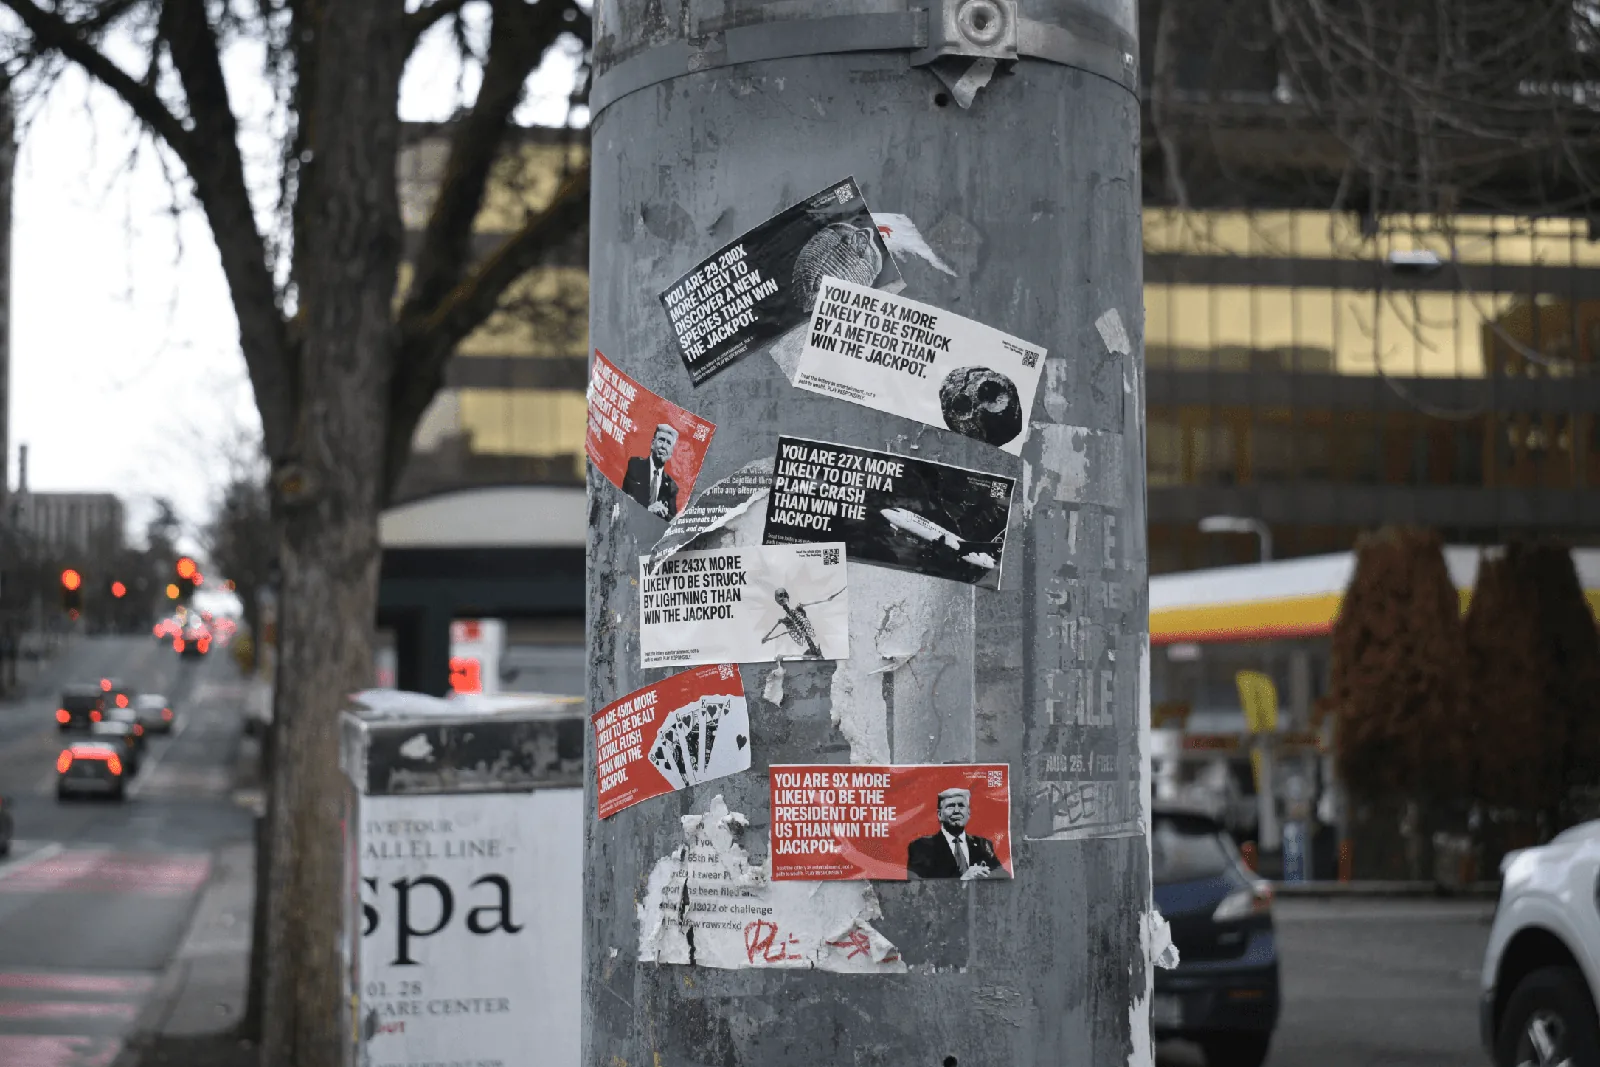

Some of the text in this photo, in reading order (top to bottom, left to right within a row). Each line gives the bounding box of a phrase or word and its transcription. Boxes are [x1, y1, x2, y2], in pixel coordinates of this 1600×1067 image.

[665, 244, 748, 307] YOU ARE 29,200X
[670, 260, 748, 322] MORE LIKELY TO
[674, 269, 762, 336] DISCOVER A NEW
[680, 278, 778, 349] SPECIES THAN WIN
[824, 286, 938, 330] YOU ARE 4X MORE
[684, 340, 706, 362] THE
[707, 309, 758, 349] JACKPOT.
[818, 301, 952, 352] LIKELY TO BE STRUCK
[814, 318, 936, 364] BY A METEOR THAN
[811, 333, 927, 379] WIN THE JACKPOT.
[618, 378, 637, 402] MORE
[618, 396, 630, 415] THE
[612, 406, 620, 424] OF
[620, 412, 632, 432] THE
[612, 424, 626, 445] THE
[782, 444, 904, 478] YOU ARE 27X MORE
[778, 460, 820, 480] LIKELY
[823, 467, 839, 482] TO
[842, 471, 863, 487] DIE
[866, 476, 881, 490] IN
[883, 478, 892, 492] A
[775, 477, 816, 496] PLANE
[819, 483, 865, 503] CRASH
[774, 492, 866, 520] THAN WIN THE
[770, 509, 831, 532] JACKPOT.
[662, 559, 679, 574] ARE
[682, 558, 706, 574] 243X
[709, 556, 741, 571] MORE
[644, 572, 747, 592] LIKELY TO BE STRUCK
[644, 588, 741, 608] BY LIGHTNING THAN
[644, 605, 734, 624] WIN THE JACKPOT.
[605, 709, 617, 726] ARE
[618, 700, 634, 720] 450X
[634, 690, 658, 712] MORE
[612, 722, 621, 738] TO
[622, 717, 631, 732] BE
[632, 707, 655, 727] DEALT
[602, 739, 619, 759] ROYAL
[620, 728, 642, 751] FLUSH
[599, 745, 643, 779] THAN WIN THE
[1046, 754, 1067, 772] AUG
[600, 768, 628, 794] JACKPOT.
[775, 773, 890, 788] YOU ARE 9X MORE
[775, 790, 884, 804] LIKELY TO BE THE
[775, 806, 896, 821] PRESIDENT OF THE
[775, 823, 889, 838] US THAN WIN THE
[445, 839, 502, 858] LINE
[776, 840, 838, 855] JACKPOT.
[699, 885, 718, 896] been
[721, 887, 739, 897] filed
[730, 905, 772, 915] challenge
[398, 981, 422, 997] 28
[427, 997, 512, 1016] CENTER
